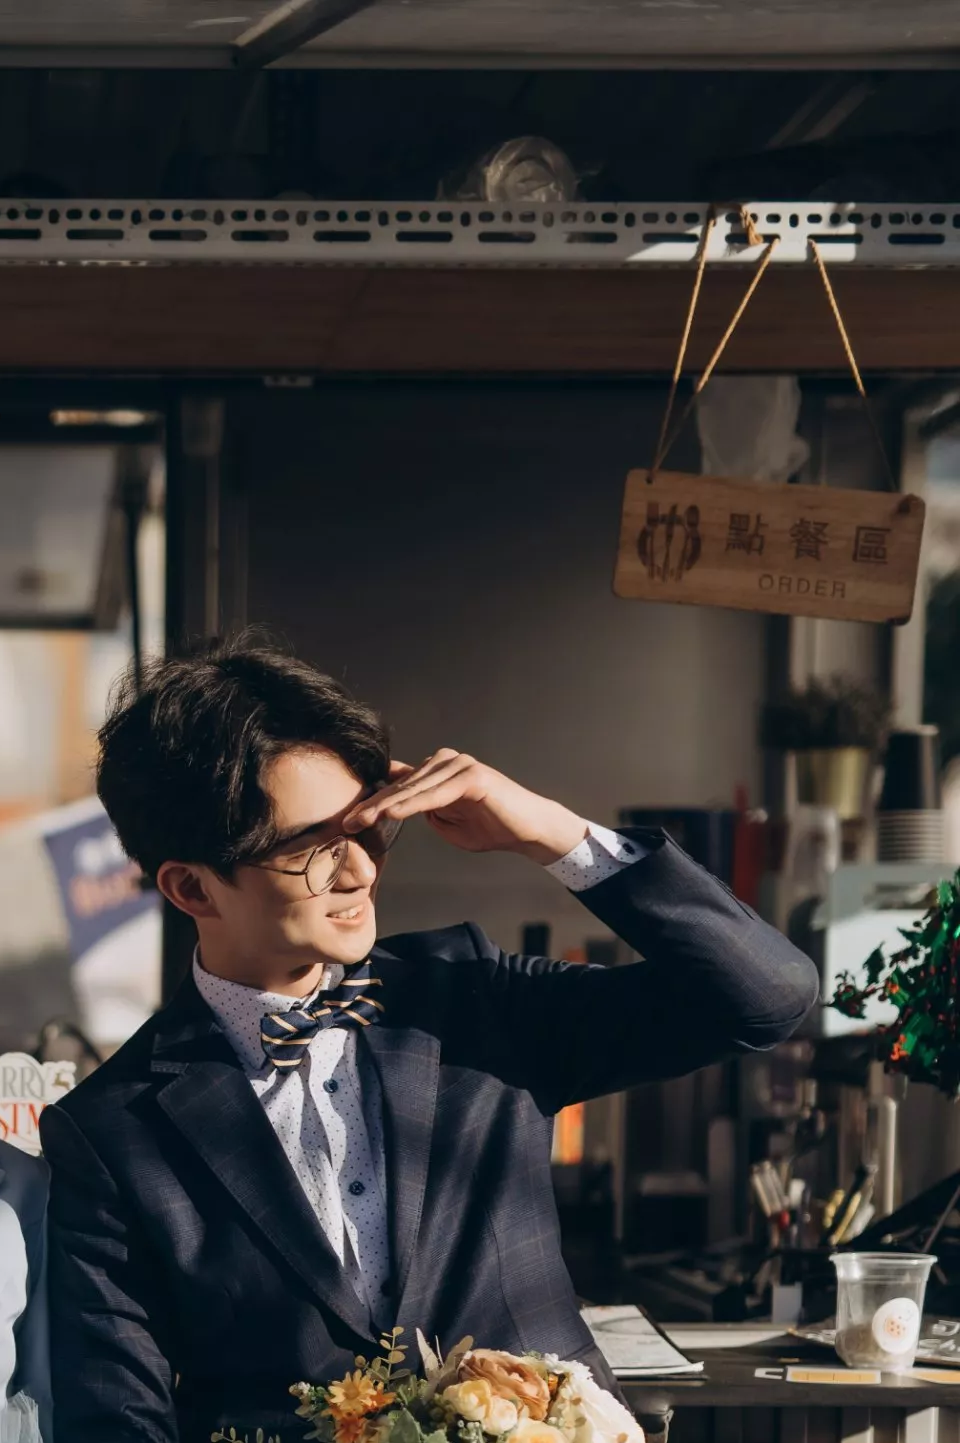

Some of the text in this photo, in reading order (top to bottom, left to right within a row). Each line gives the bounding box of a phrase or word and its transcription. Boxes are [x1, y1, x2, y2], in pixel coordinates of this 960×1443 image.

[725, 513, 891, 564] 點餐區
[758, 574, 846, 599] ORDER
